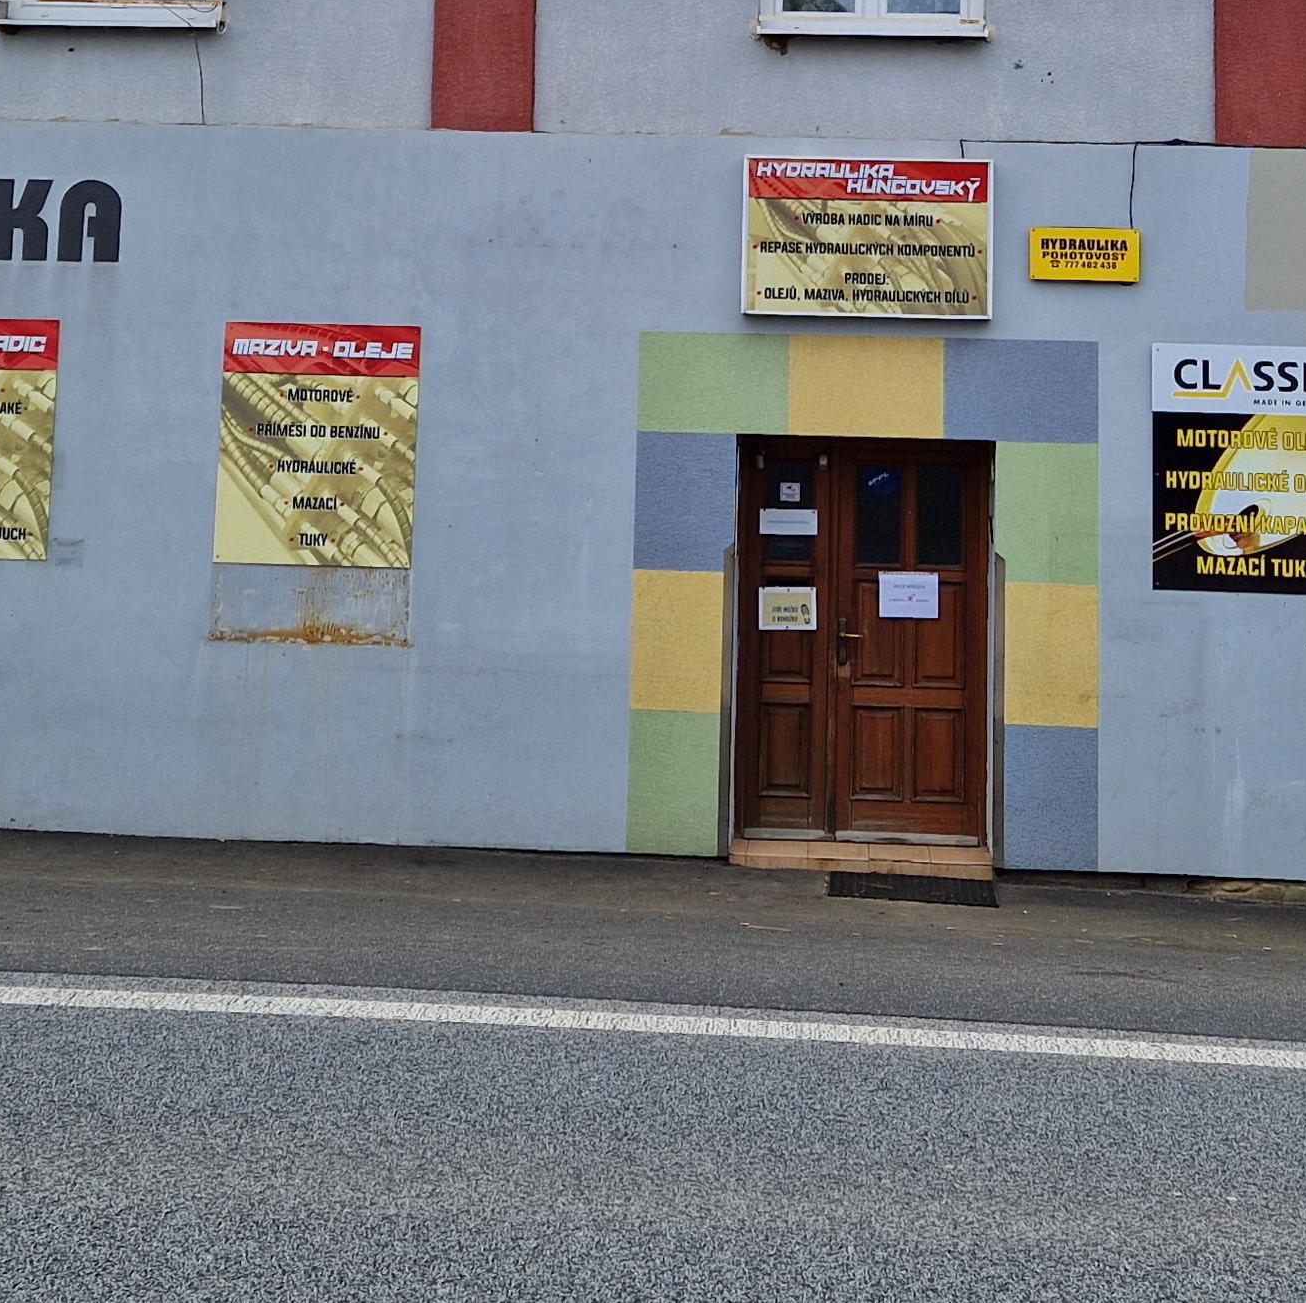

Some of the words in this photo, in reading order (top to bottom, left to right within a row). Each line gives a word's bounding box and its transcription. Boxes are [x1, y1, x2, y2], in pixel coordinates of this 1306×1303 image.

[756, 161, 896, 180] HYDRAULIKA
[802, 210, 846, 226] VÝROBA
[848, 213, 881, 226] HADIC
[884, 214, 901, 227] NA
[903, 212, 933, 227] MÍRU
[760, 241, 803, 254] REPASE
[805, 240, 894, 256] HYDRAULICKÝCH
[1040, 238, 1128, 251] HYDRAULIKA
[1042, 251, 1126, 261] POHOTOVOST
[844, 272, 889, 286] PRODEJ:
[232, 338, 319, 357] MAZIVA
[332, 341, 414, 360] OLEJE
[287, 387, 354, 403] MOTOROVÉ
[1253, 398, 1278, 406] MADE
[1281, 399, 1291, 407] IN
[256, 422, 307, 438] PŘÍMĚSI
[310, 425, 326, 439] DO
[330, 424, 381, 440] BENZÍNU
[1176, 427, 1278, 450] MOTOROVÉ
[276, 459, 358, 475] HYDRAULICKÉ
[1165, 470, 1289, 493] HYDRAULICKÉ
[292, 494, 338, 511] MAZACÍ
[1164, 512, 1255, 534] PROVOZNÍ
[298, 533, 328, 547] TUKY
[1196, 554, 1266, 577] MAZACÍ
